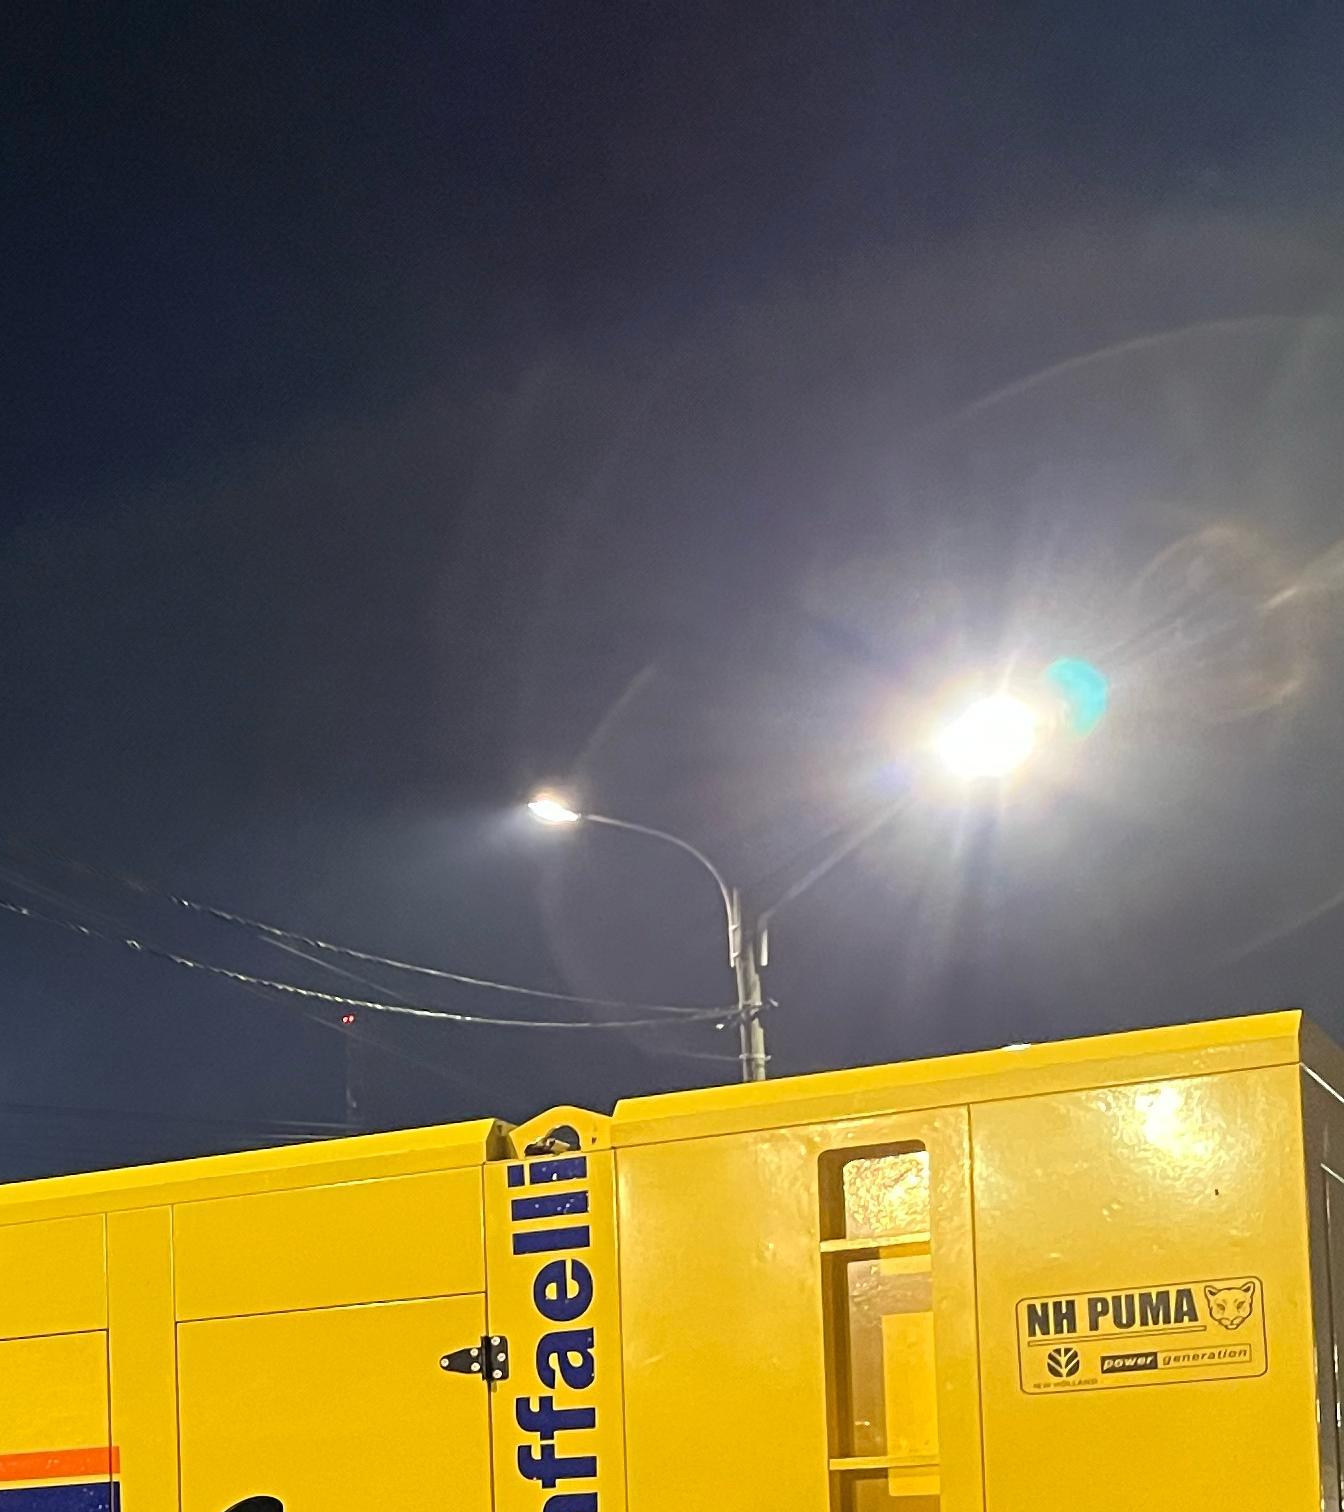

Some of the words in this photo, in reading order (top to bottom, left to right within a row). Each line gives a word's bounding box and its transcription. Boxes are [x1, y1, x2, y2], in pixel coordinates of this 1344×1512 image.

[1027, 1299, 1077, 1338] NH
[1088, 1288, 1199, 1332] PUMA
[1102, 1354, 1155, 1370] power
[1162, 1348, 1249, 1367] generation
